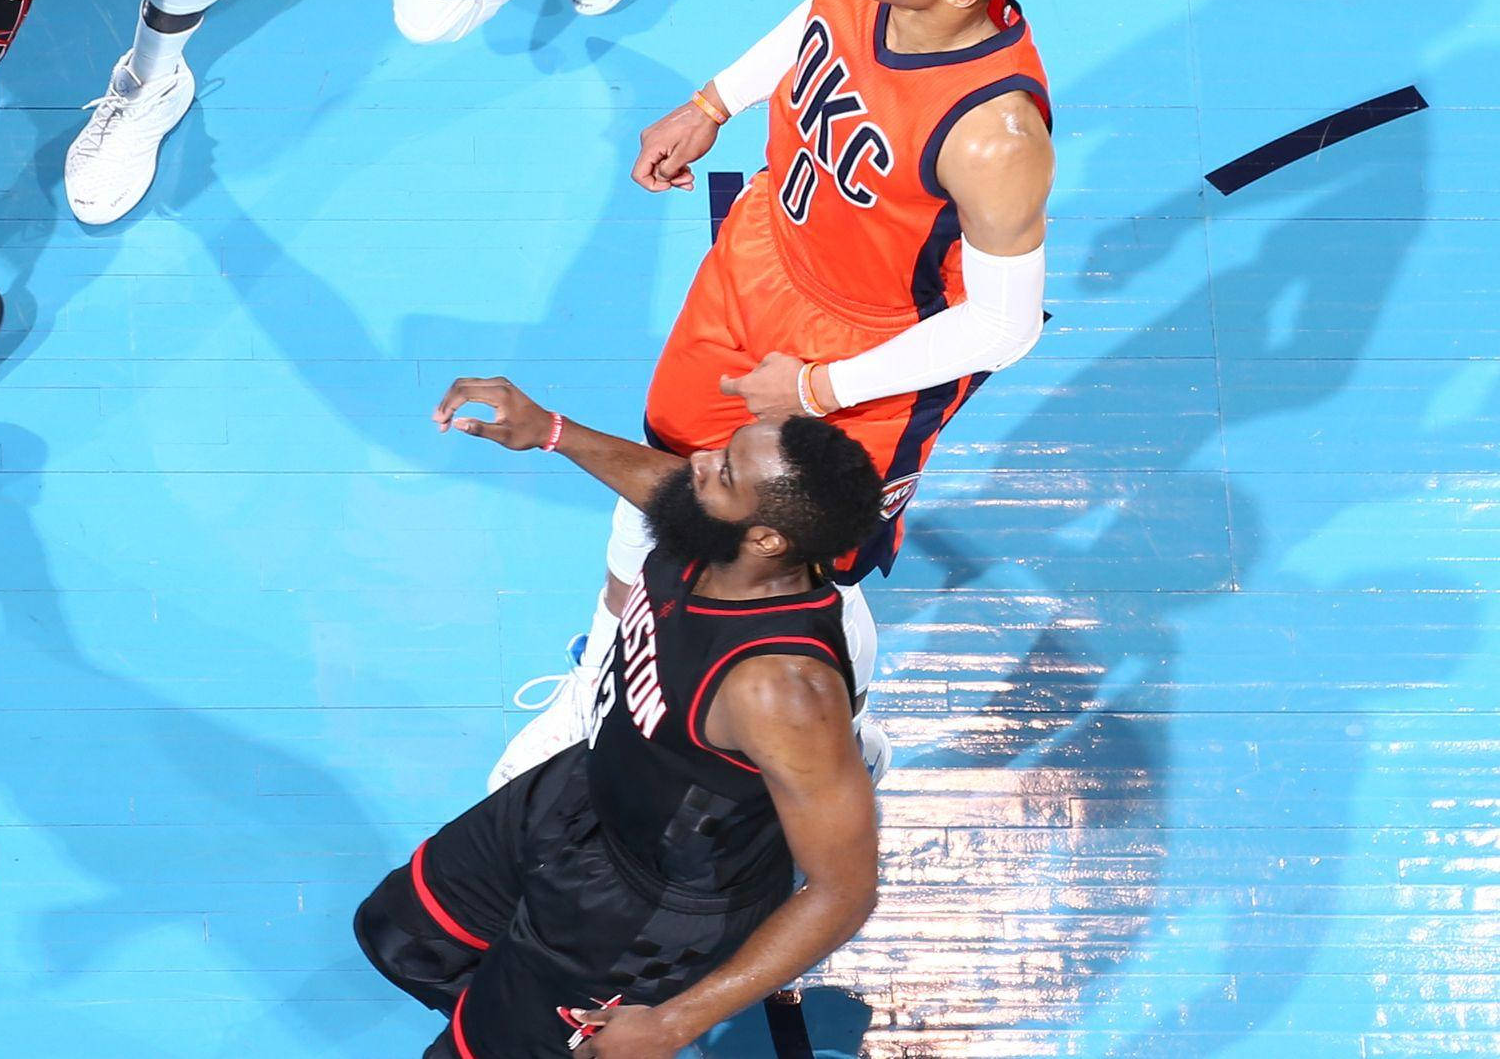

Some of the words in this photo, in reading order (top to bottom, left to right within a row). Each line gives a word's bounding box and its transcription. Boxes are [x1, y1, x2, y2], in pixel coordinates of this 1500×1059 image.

[778, 146, 820, 226] 0
[789, 15, 895, 209] OKC
[619, 572, 668, 740] OUSTON
